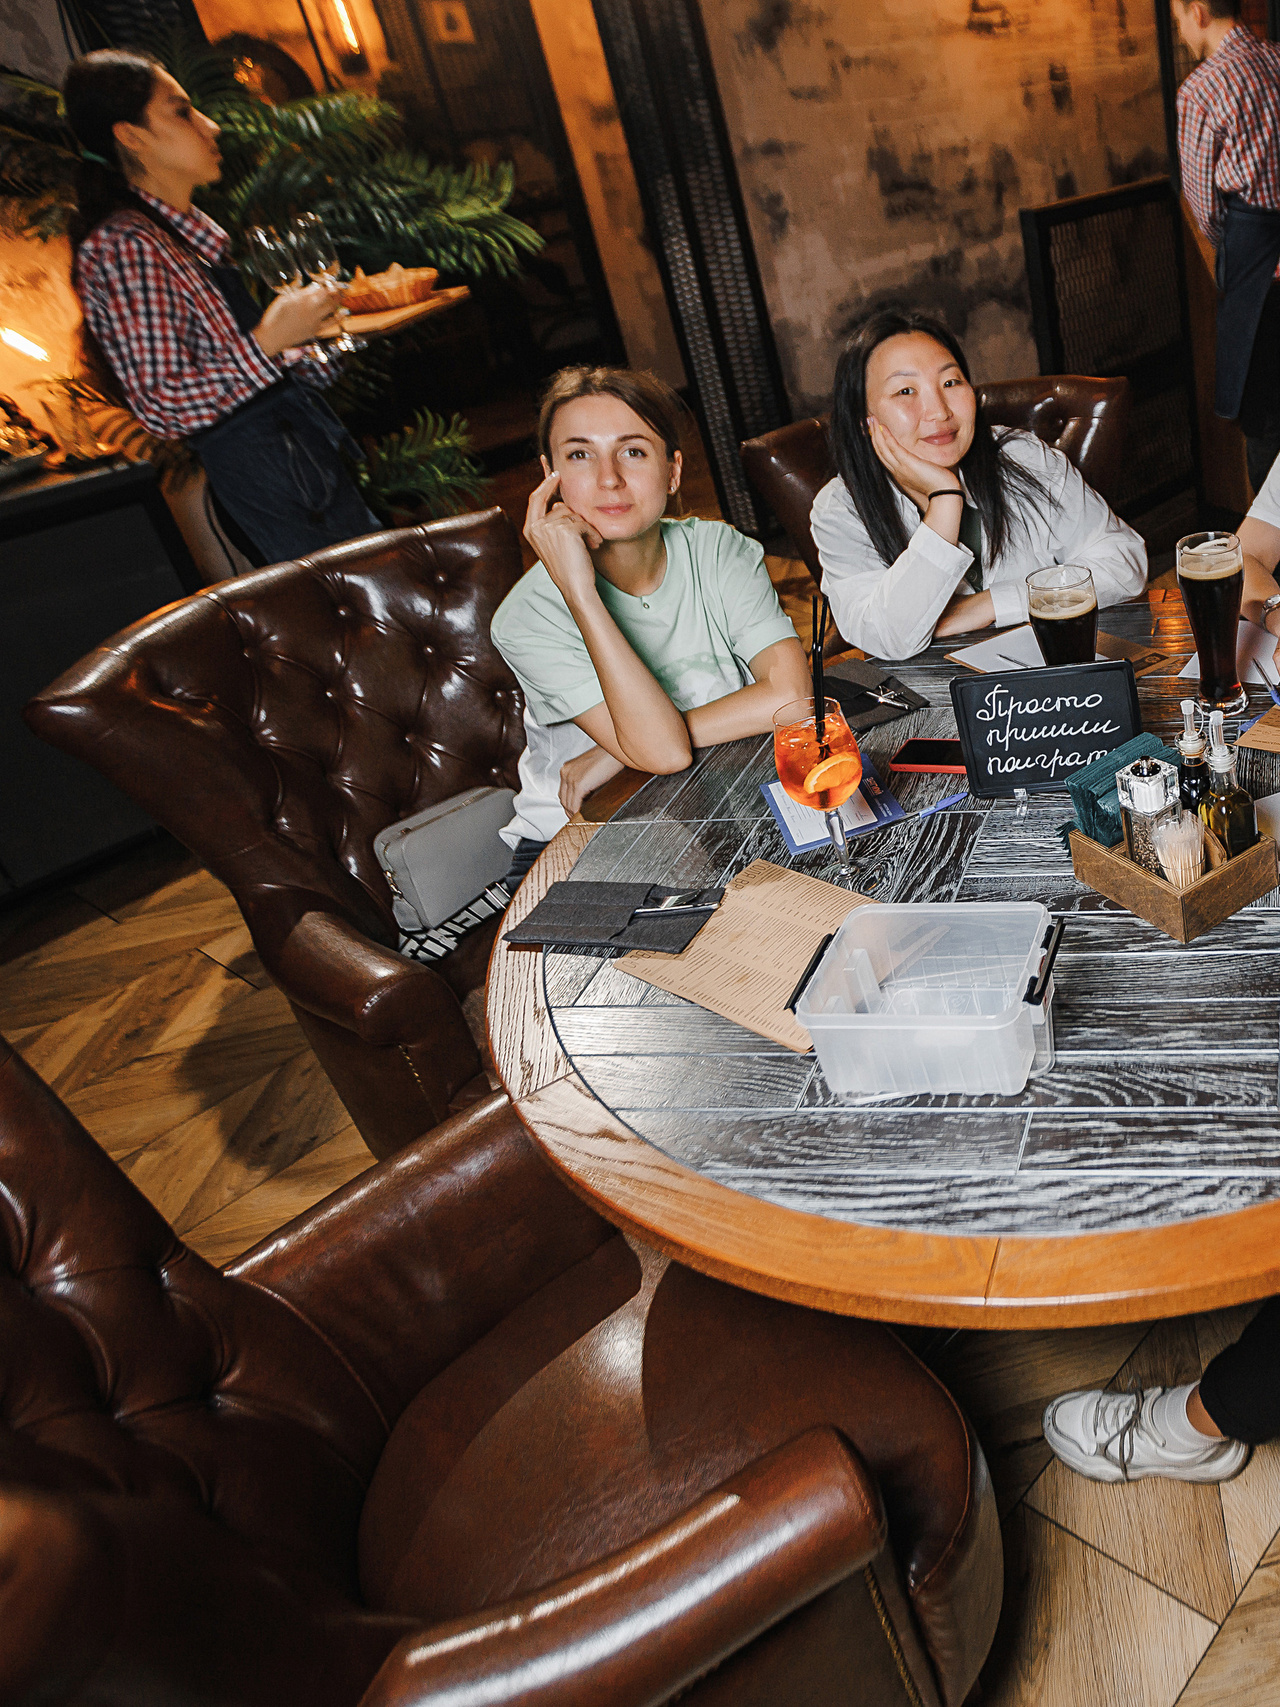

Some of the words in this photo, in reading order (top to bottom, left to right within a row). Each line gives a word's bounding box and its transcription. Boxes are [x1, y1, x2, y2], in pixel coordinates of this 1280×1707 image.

[976, 684, 1103, 724] Просто
[986, 719, 1121, 751] пришли
[986, 748, 1117, 778] поиграт
